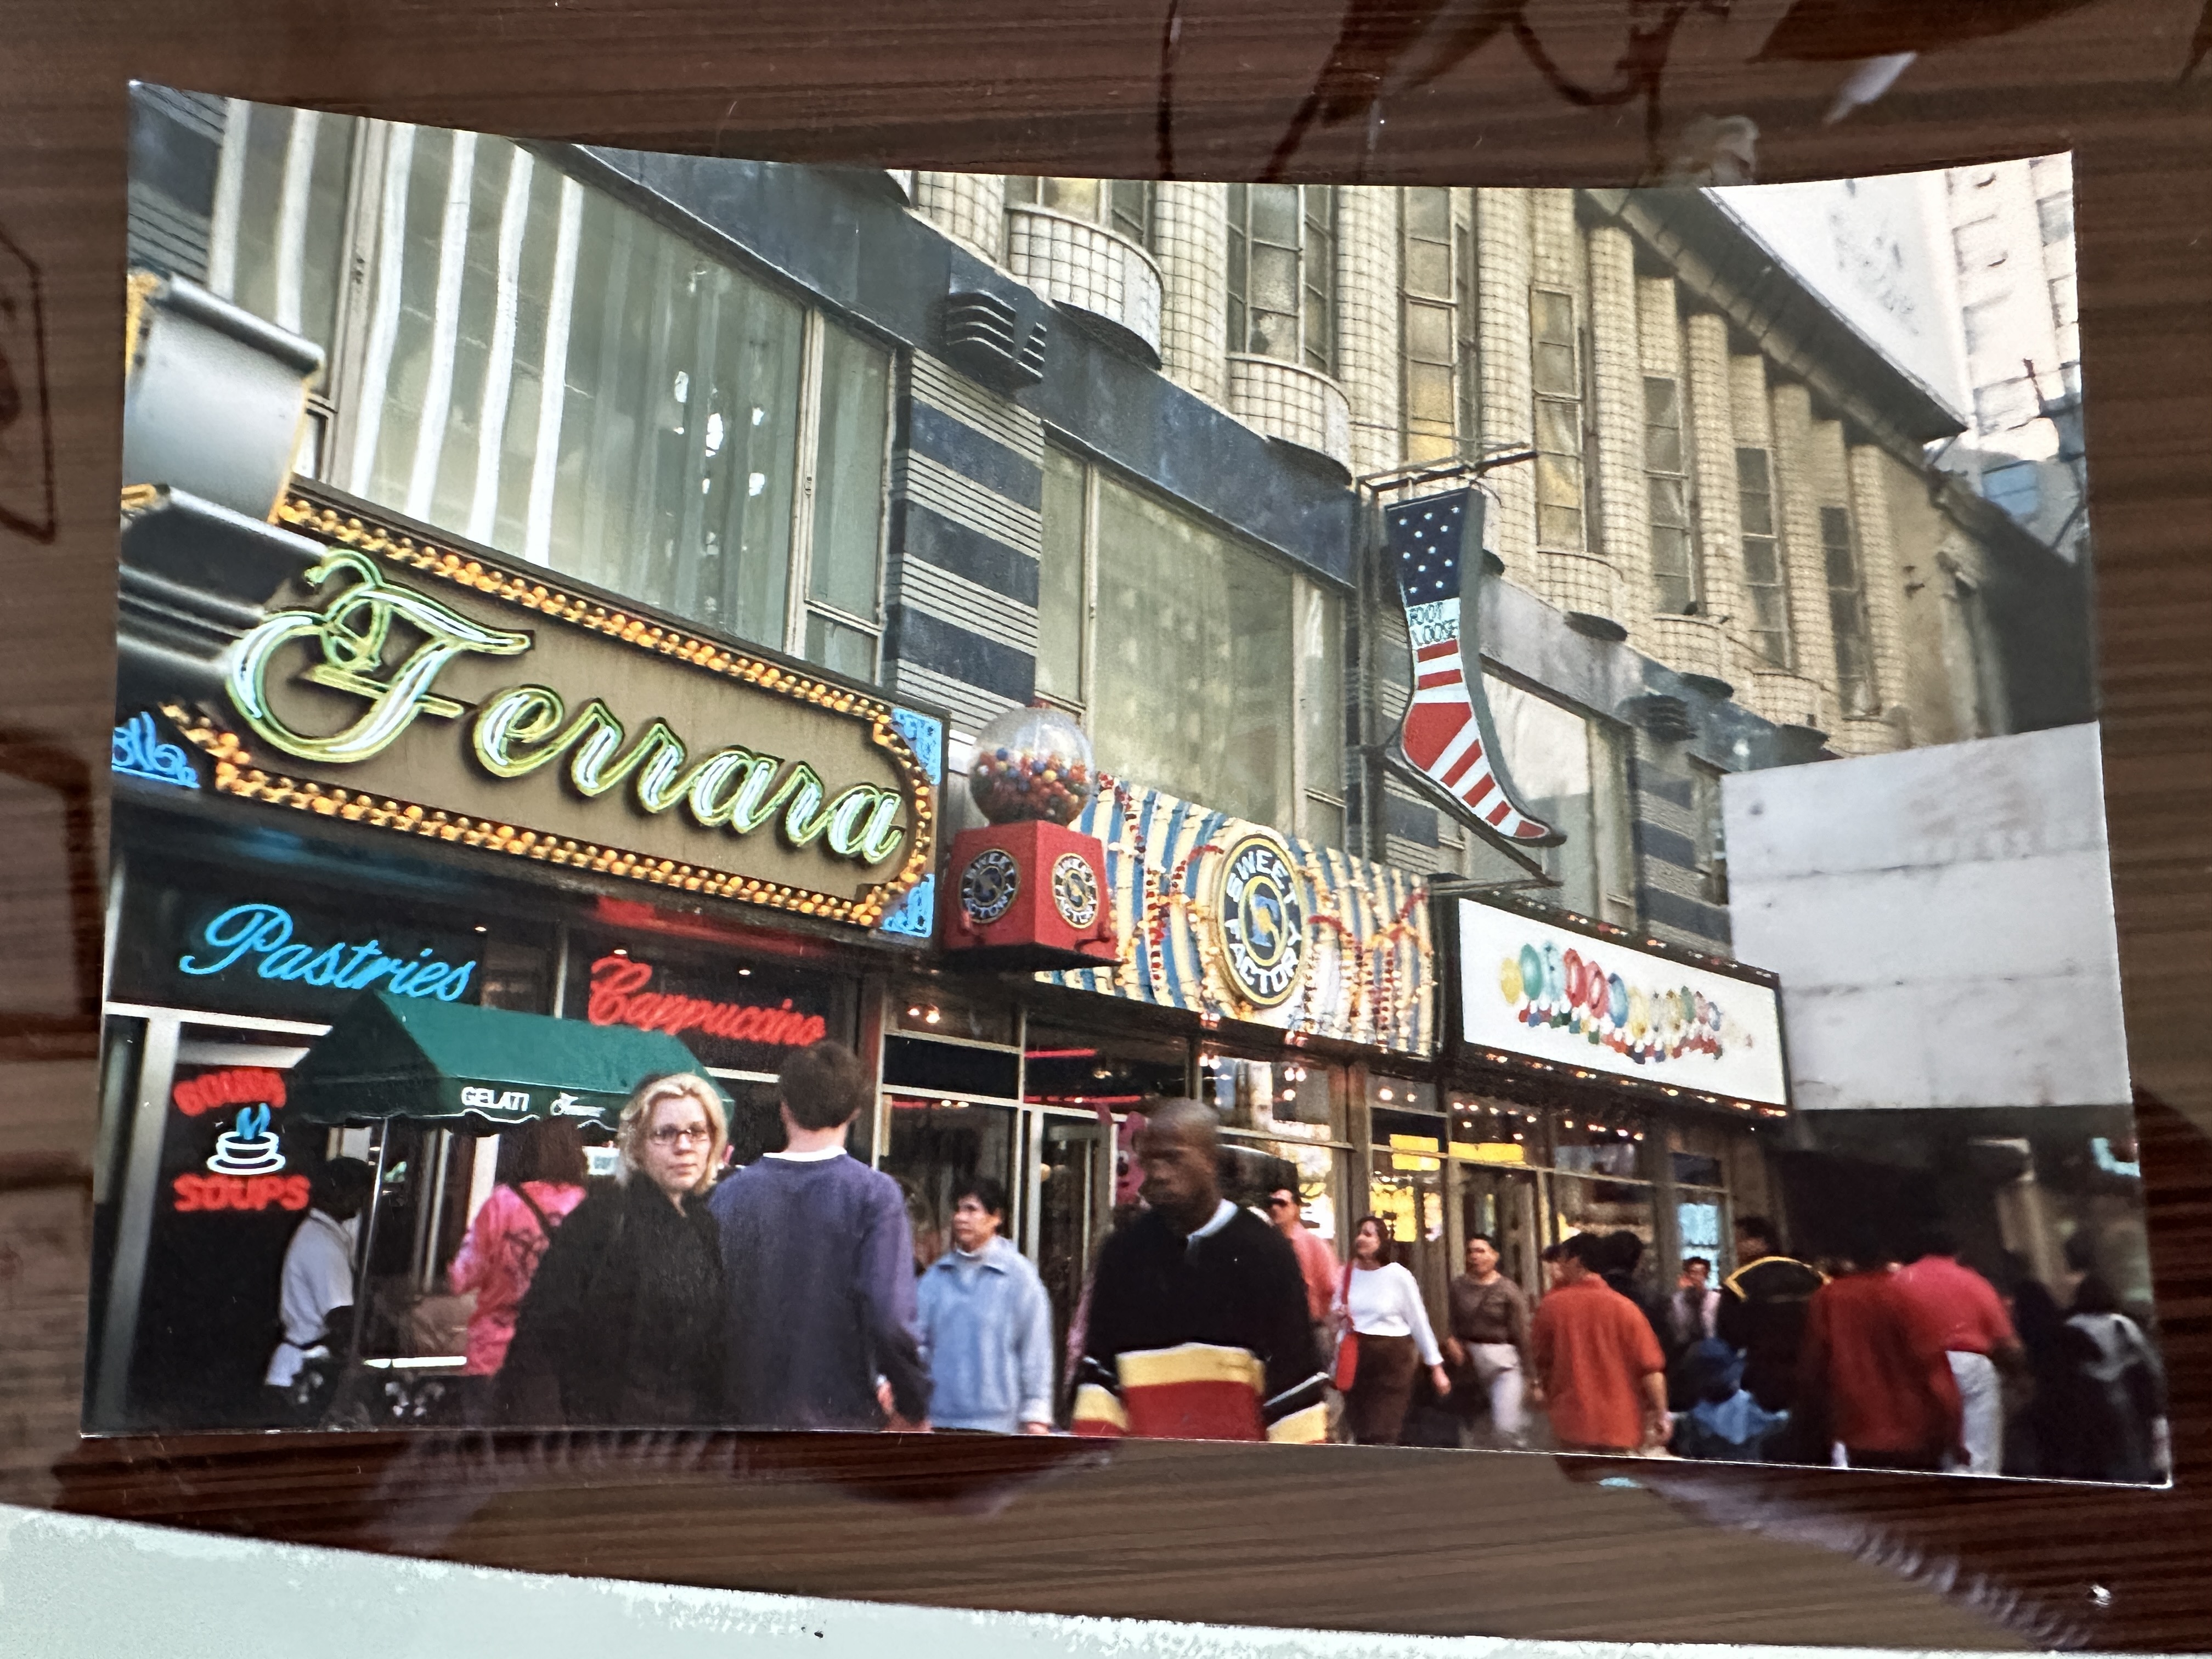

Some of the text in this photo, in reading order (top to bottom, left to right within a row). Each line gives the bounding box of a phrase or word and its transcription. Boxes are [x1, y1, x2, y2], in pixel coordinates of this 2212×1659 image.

[224, 549, 905, 865] Ferrara
[1227, 849, 1299, 905] SWEET
[179, 902, 476, 1001] Pastries
[1224, 919, 1302, 994] FACTORY
[173, 1173, 311, 1212] SOUPS
